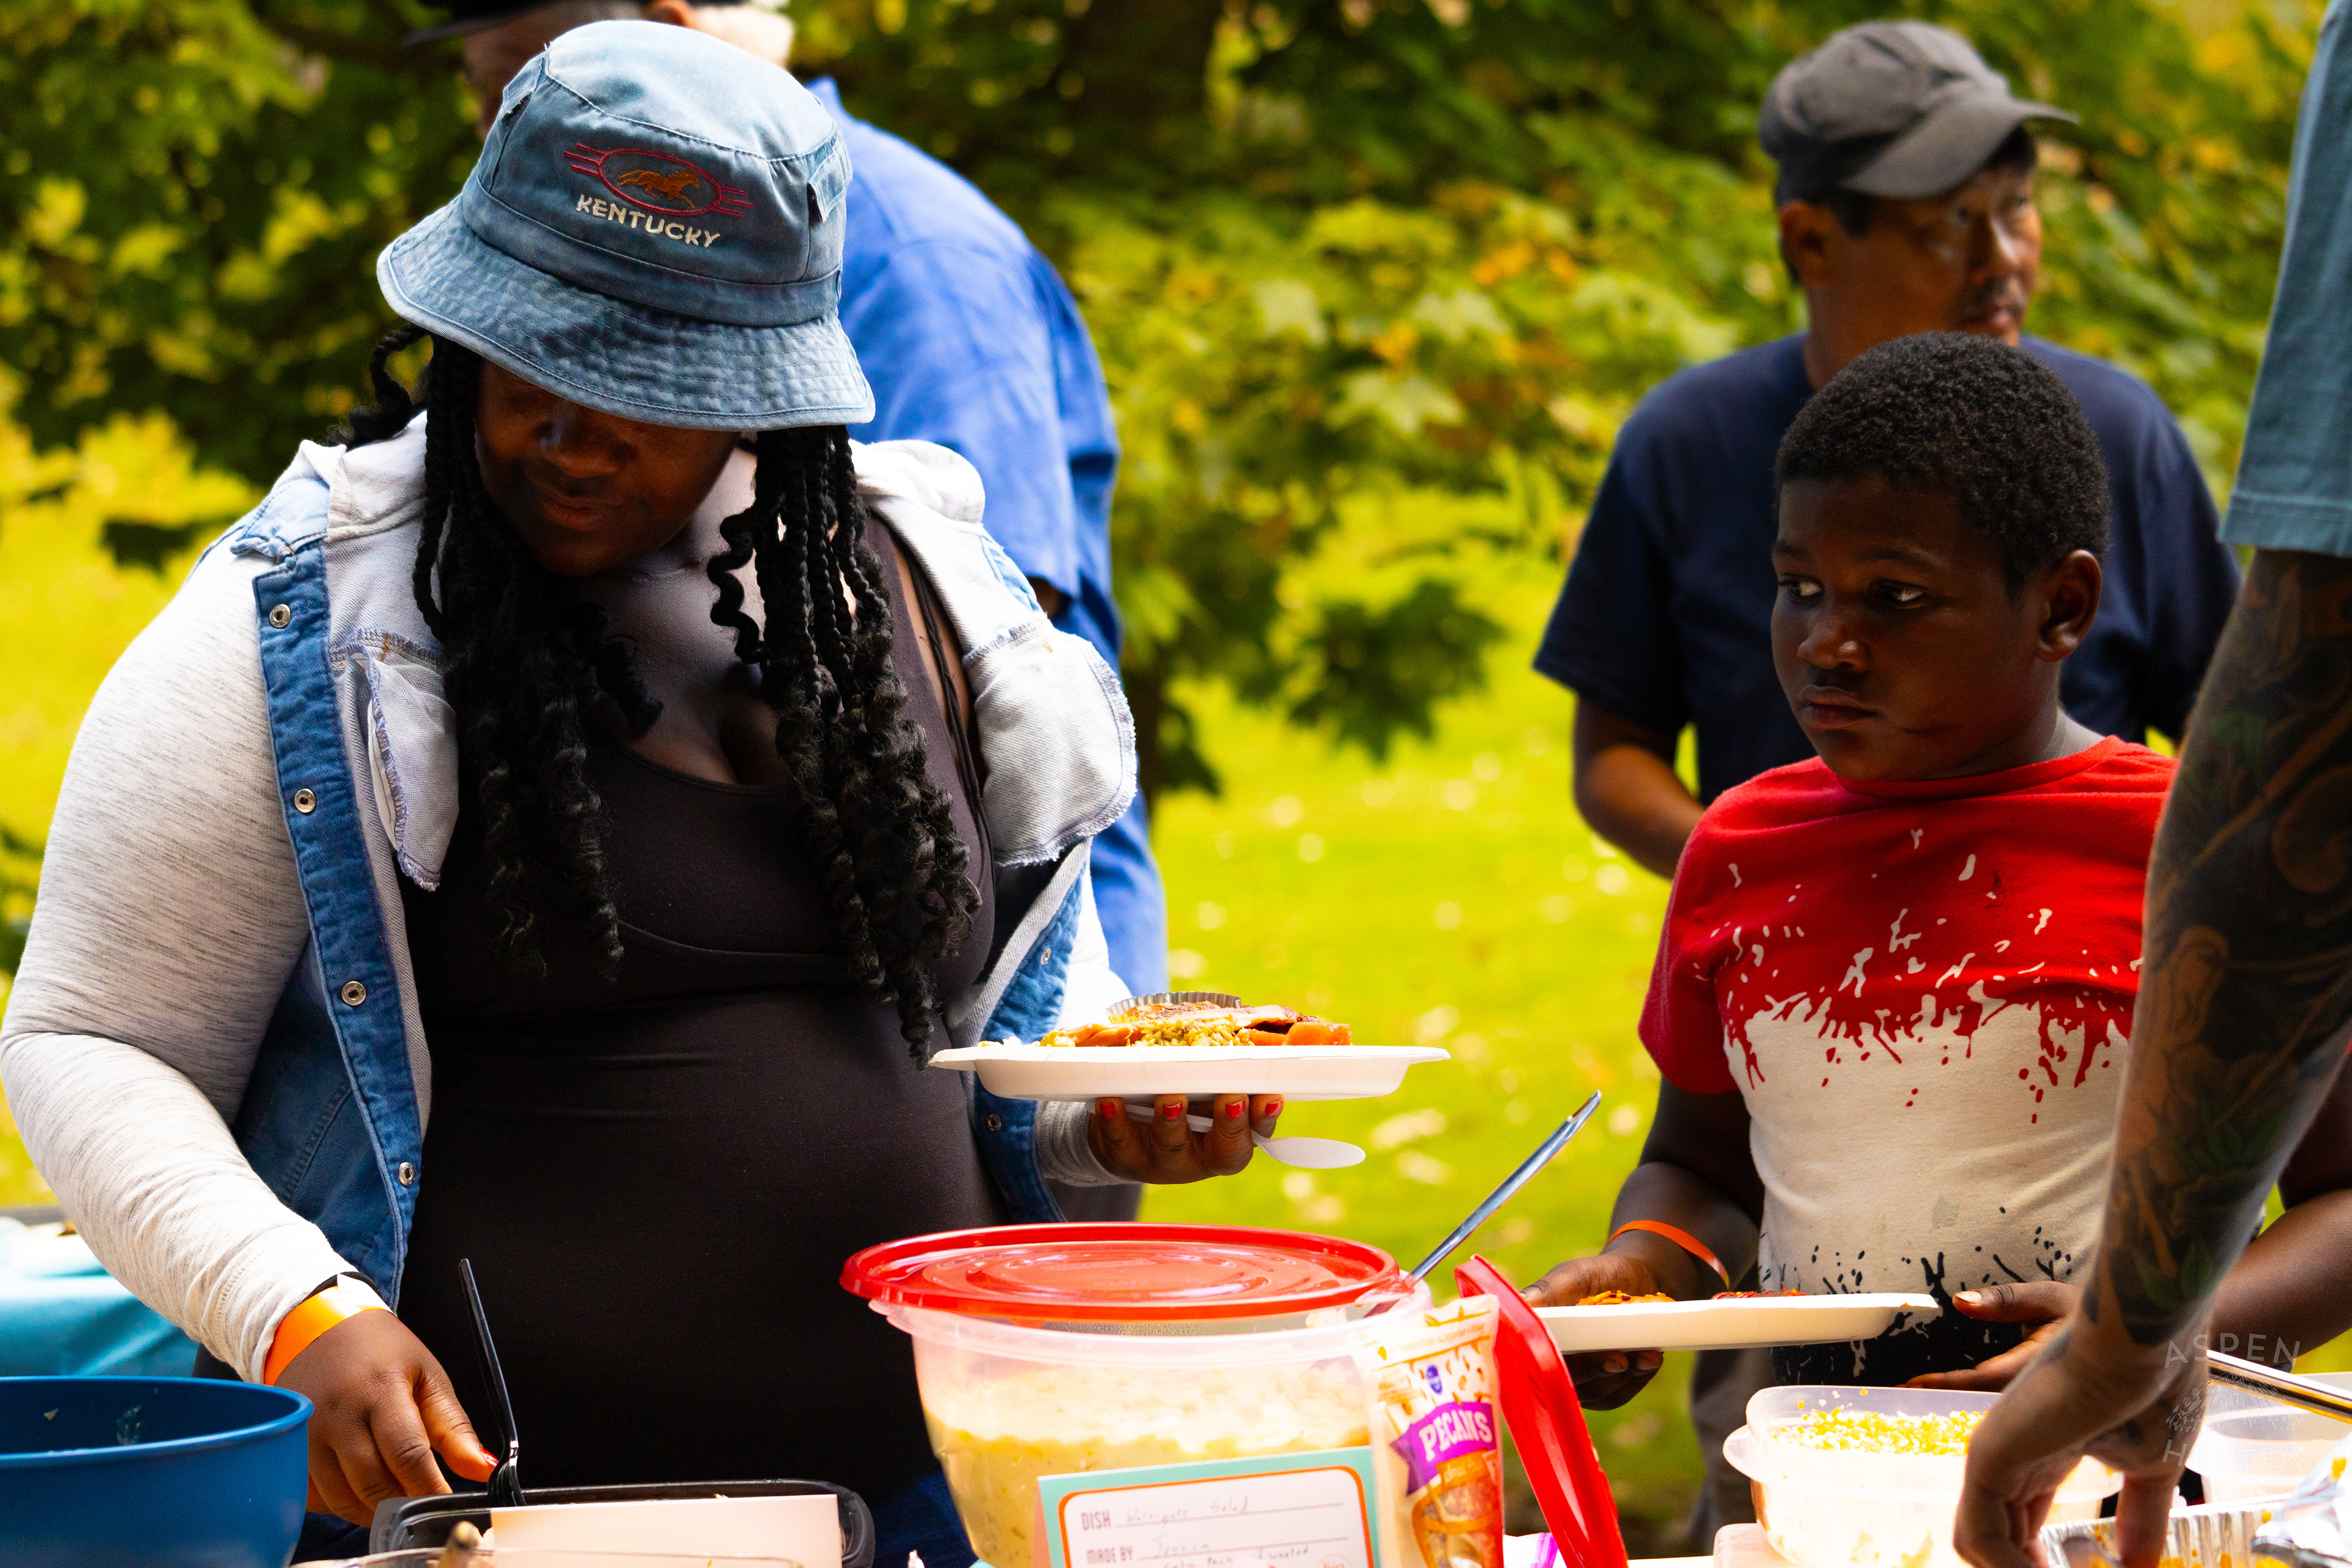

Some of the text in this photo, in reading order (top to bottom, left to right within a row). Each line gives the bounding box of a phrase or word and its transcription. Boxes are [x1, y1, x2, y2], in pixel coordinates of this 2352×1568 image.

[576, 194, 720, 247] KENTUCKY
[1419, 1409, 1493, 1463] PECANS
[1080, 1510, 1112, 1531] DISH
[1086, 1545, 1134, 1566] MADE BY
